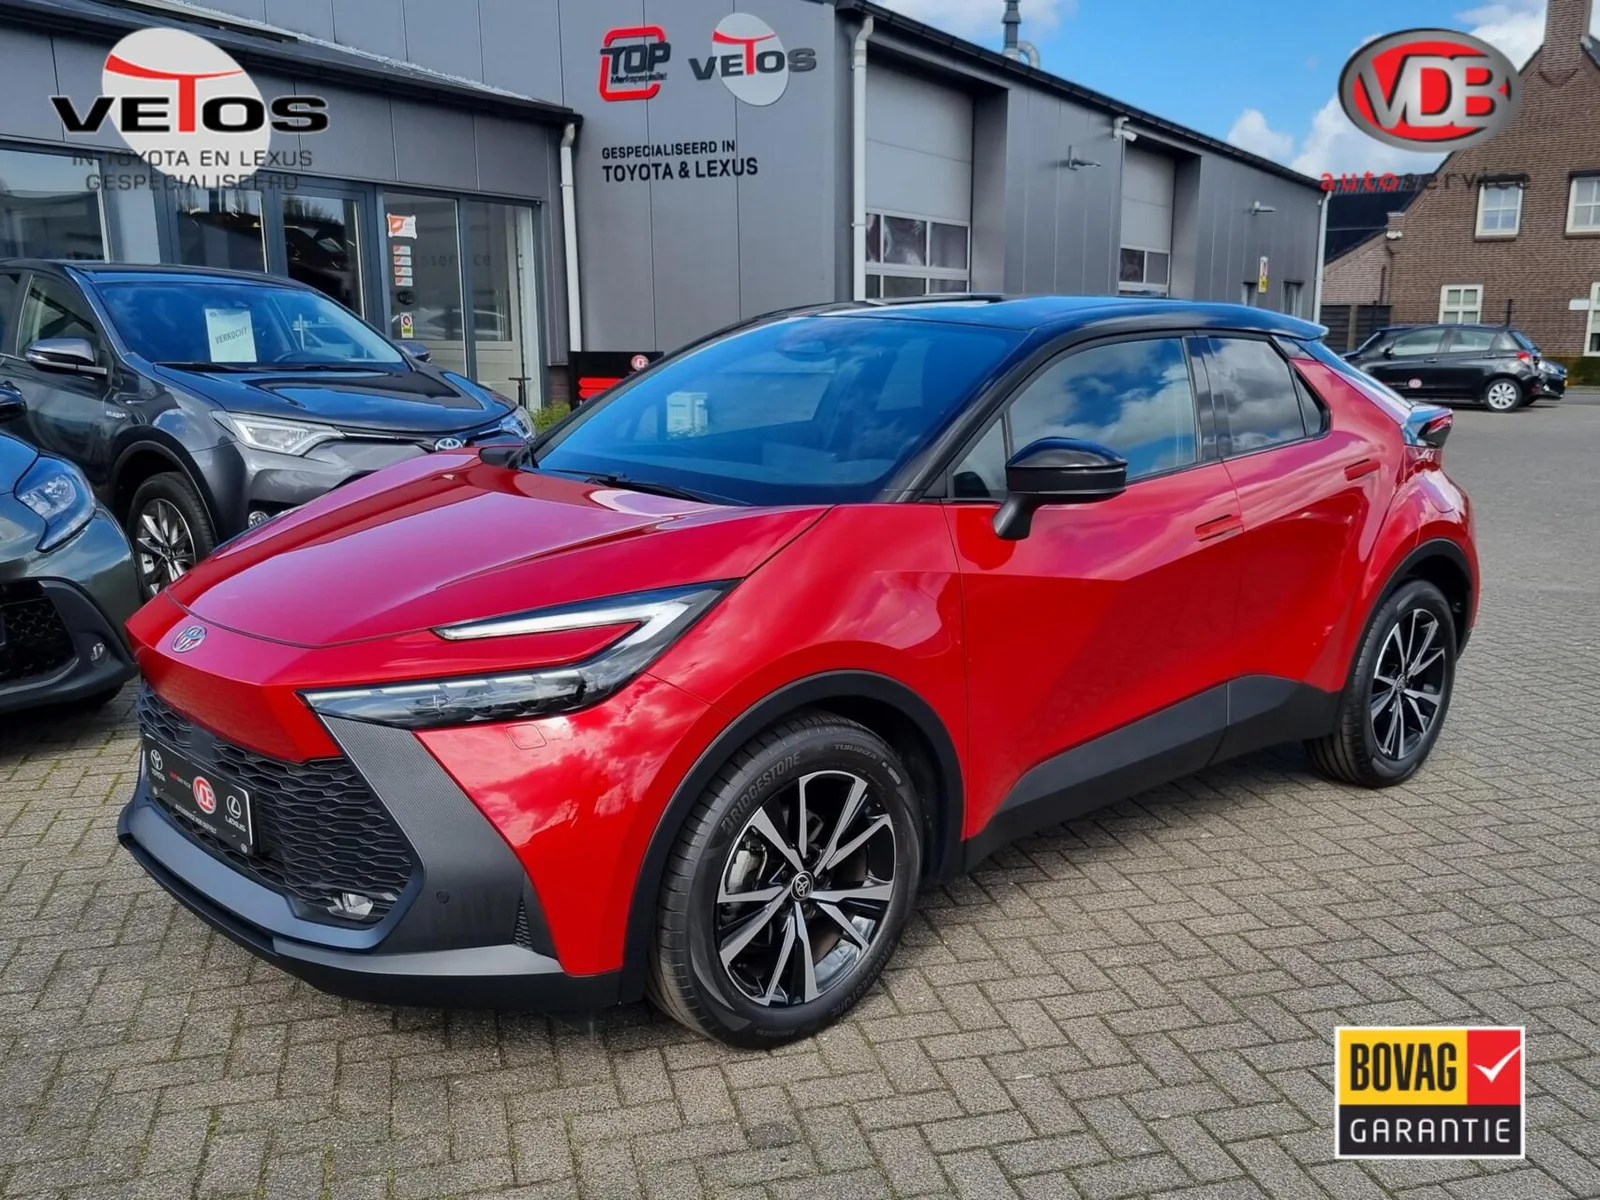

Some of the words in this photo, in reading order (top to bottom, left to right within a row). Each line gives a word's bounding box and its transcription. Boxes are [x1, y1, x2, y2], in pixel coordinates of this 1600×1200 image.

[600, 42, 671, 76] TOP
[688, 39, 817, 82] VETOS
[601, 142, 717, 159] GESPECIALISEERD
[722, 140, 736, 153] IN
[601, 161, 674, 183] TOYOTA
[678, 161, 691, 179] &
[695, 157, 759, 179] LEXUS
[214, 326, 248, 345] VERKOCHT
[720, 750, 801, 835] BRIDGESTONE
